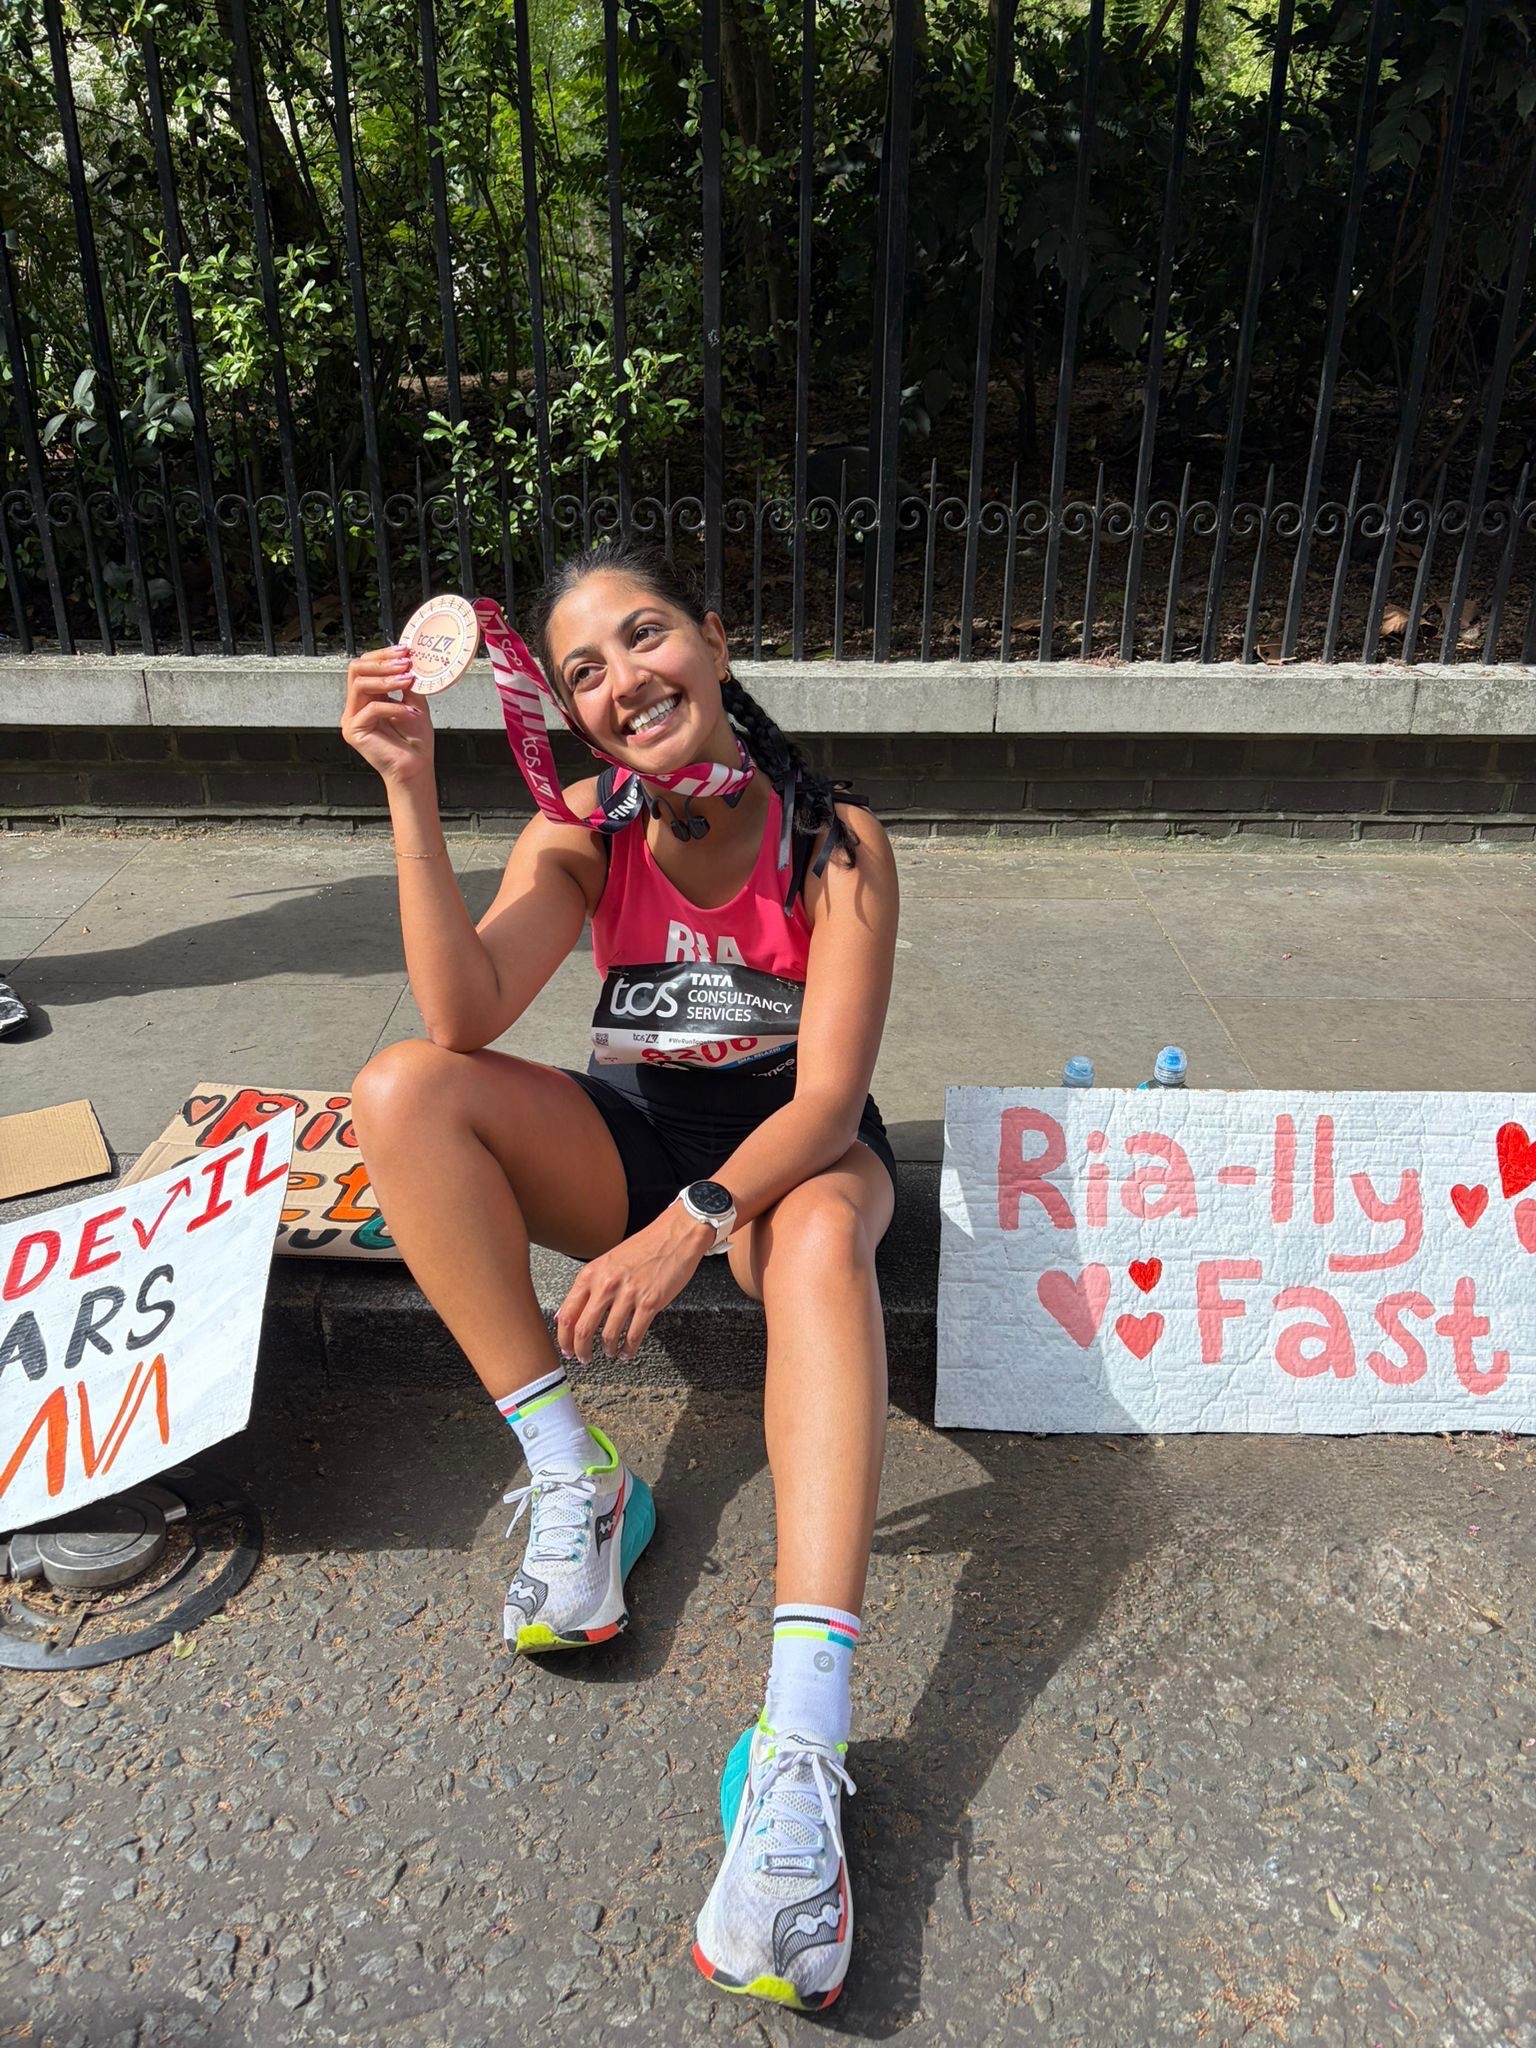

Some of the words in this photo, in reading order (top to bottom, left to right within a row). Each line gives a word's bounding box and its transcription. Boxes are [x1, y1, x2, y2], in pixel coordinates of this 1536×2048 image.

[521, 735, 542, 769] tcs
[608, 781, 639, 821] FINIS
[665, 919, 748, 967] RIA
[609, 977, 679, 1019] tcs
[687, 989, 793, 1015] CONSULTANCY
[689, 972, 734, 988] TATA
[686, 1006, 752, 1022] SERVICES
[998, 1105, 1424, 1273] Ria-lly
[1196, 1258, 1510, 1396] Fast
